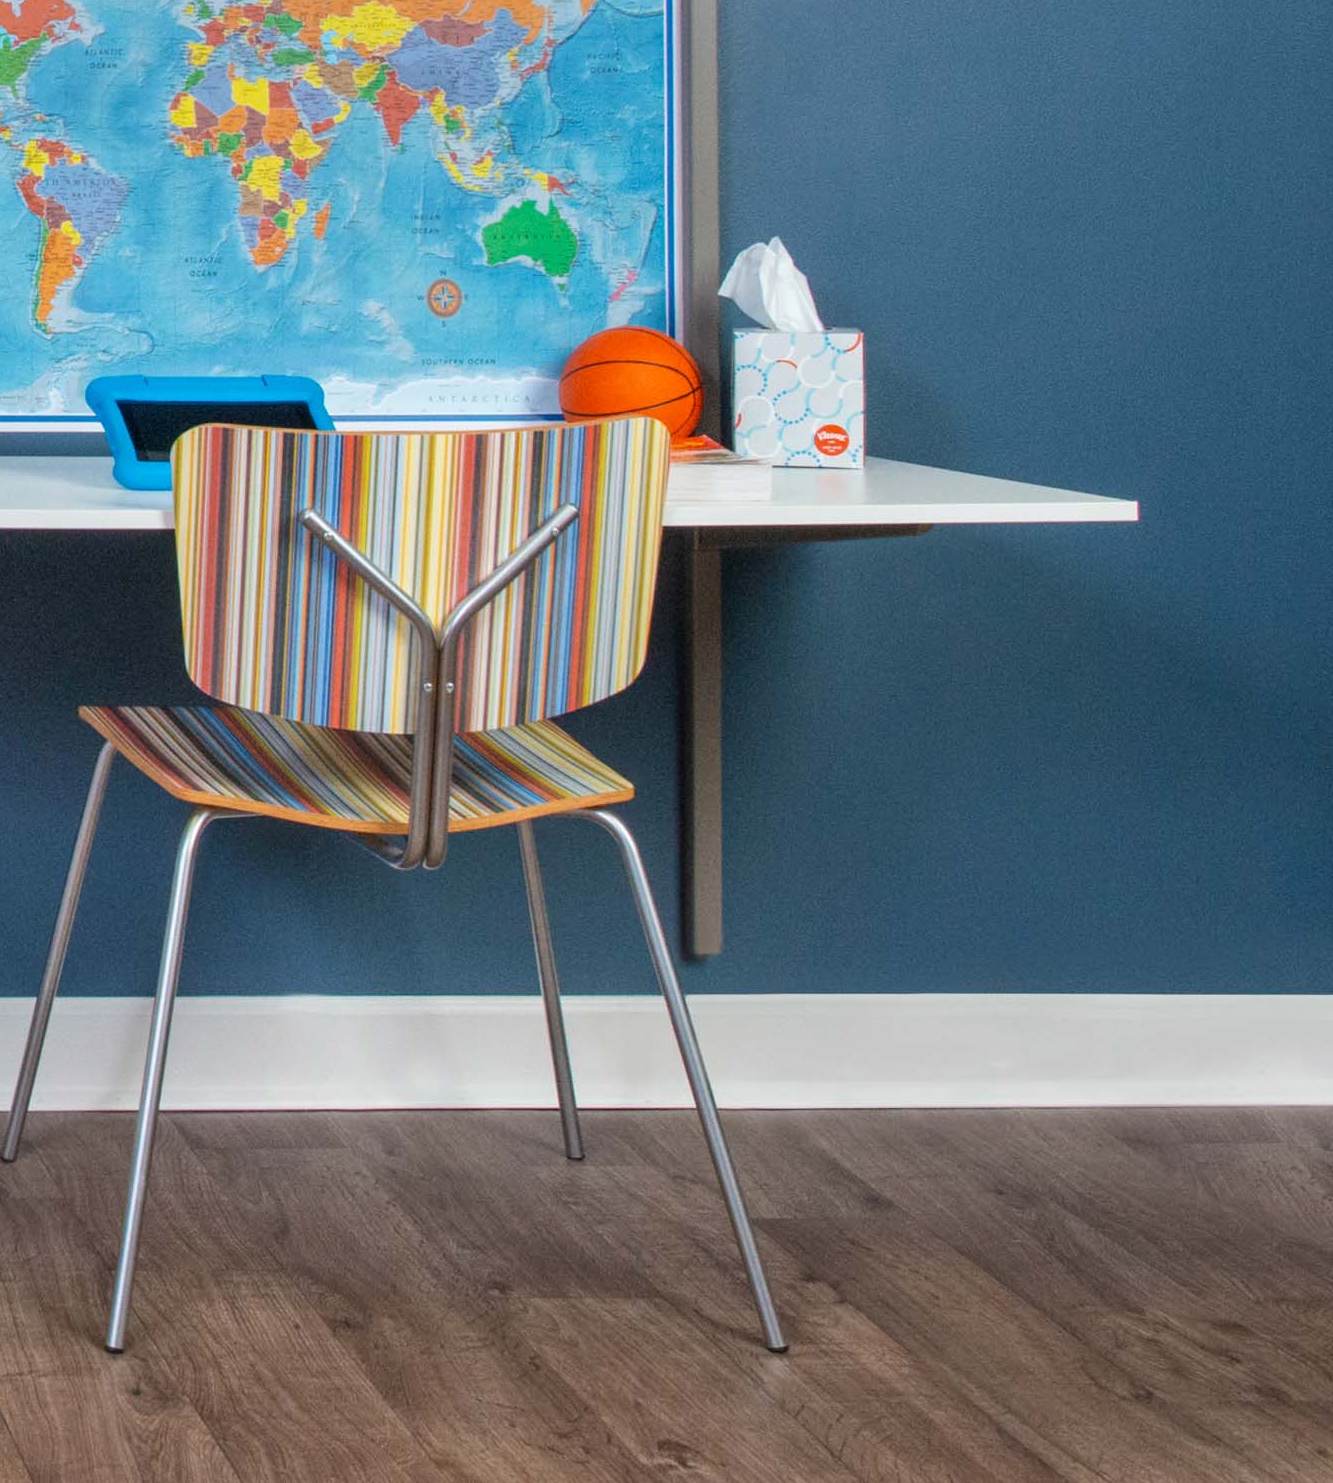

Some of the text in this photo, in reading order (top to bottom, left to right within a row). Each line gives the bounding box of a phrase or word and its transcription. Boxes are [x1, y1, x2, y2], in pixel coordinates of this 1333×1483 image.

[421, 357, 497, 366] SOUTHERN OCEAN
[428, 394, 532, 404] ANTARCTICA
